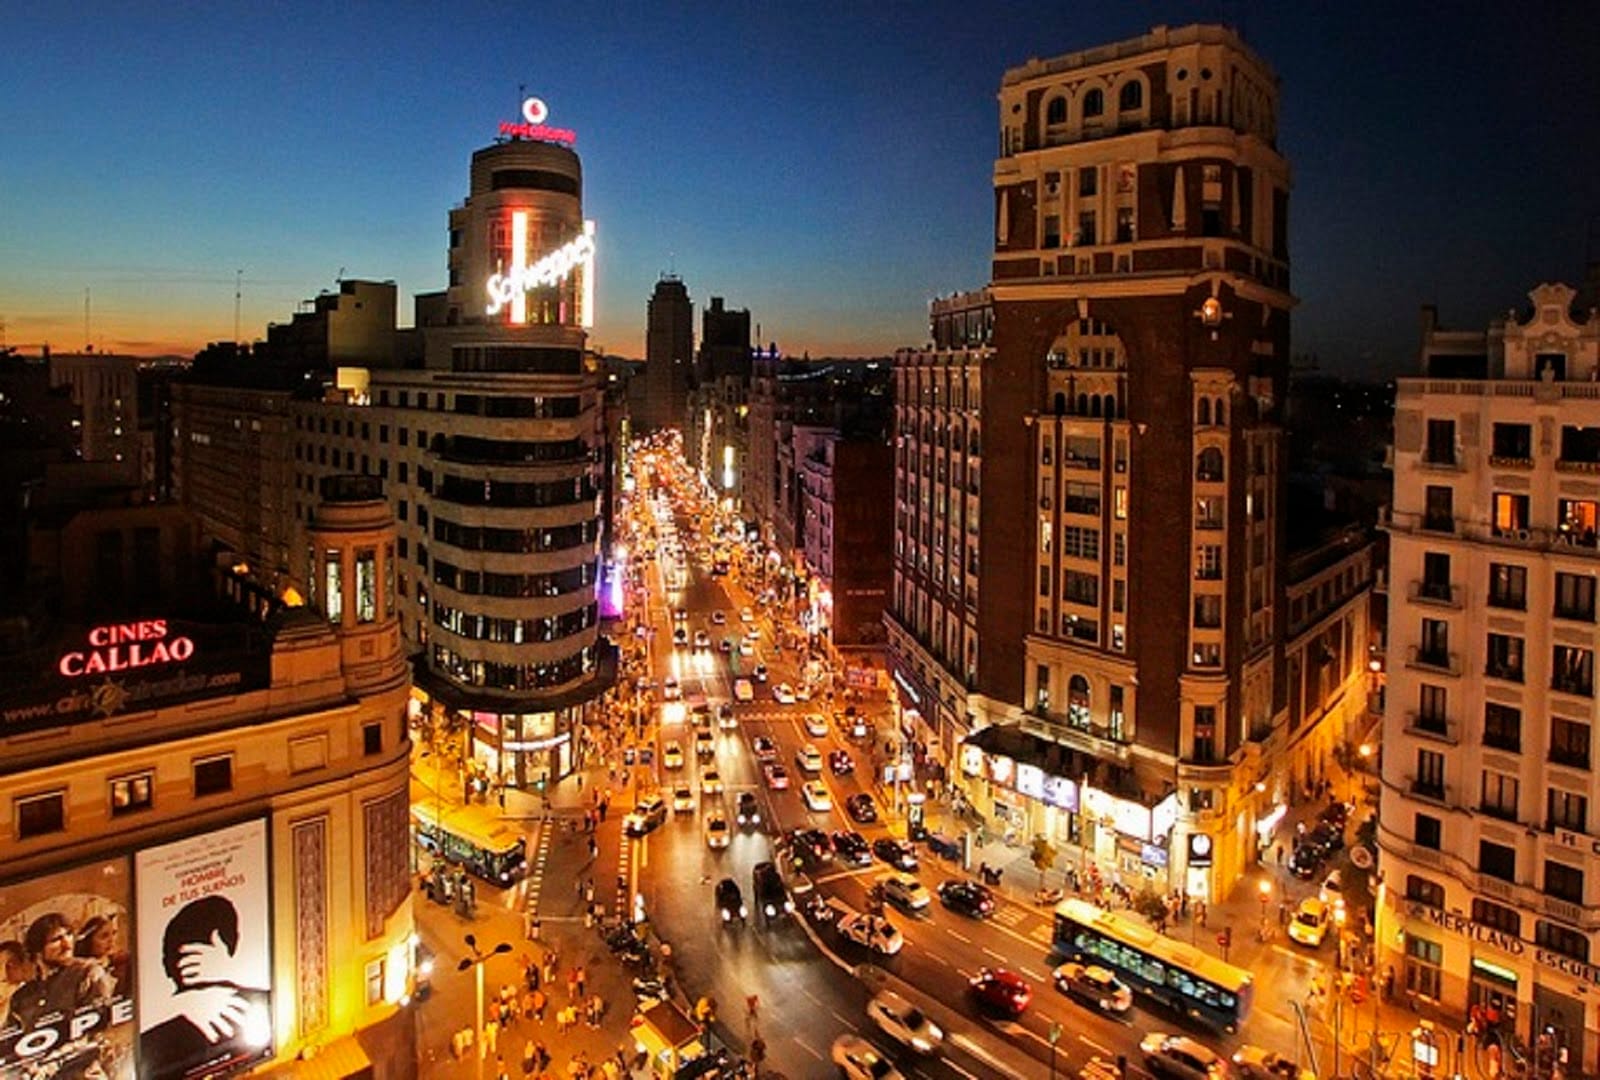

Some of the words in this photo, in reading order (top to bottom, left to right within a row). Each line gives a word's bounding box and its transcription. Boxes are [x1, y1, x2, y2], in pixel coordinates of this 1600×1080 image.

[89, 620, 168, 646] CINES
[59, 637, 194, 677] CALLAO
[162, 894, 177, 907] DE
[1430, 907, 1524, 955] MERYLAND
[0, 999, 134, 1067] OPE
